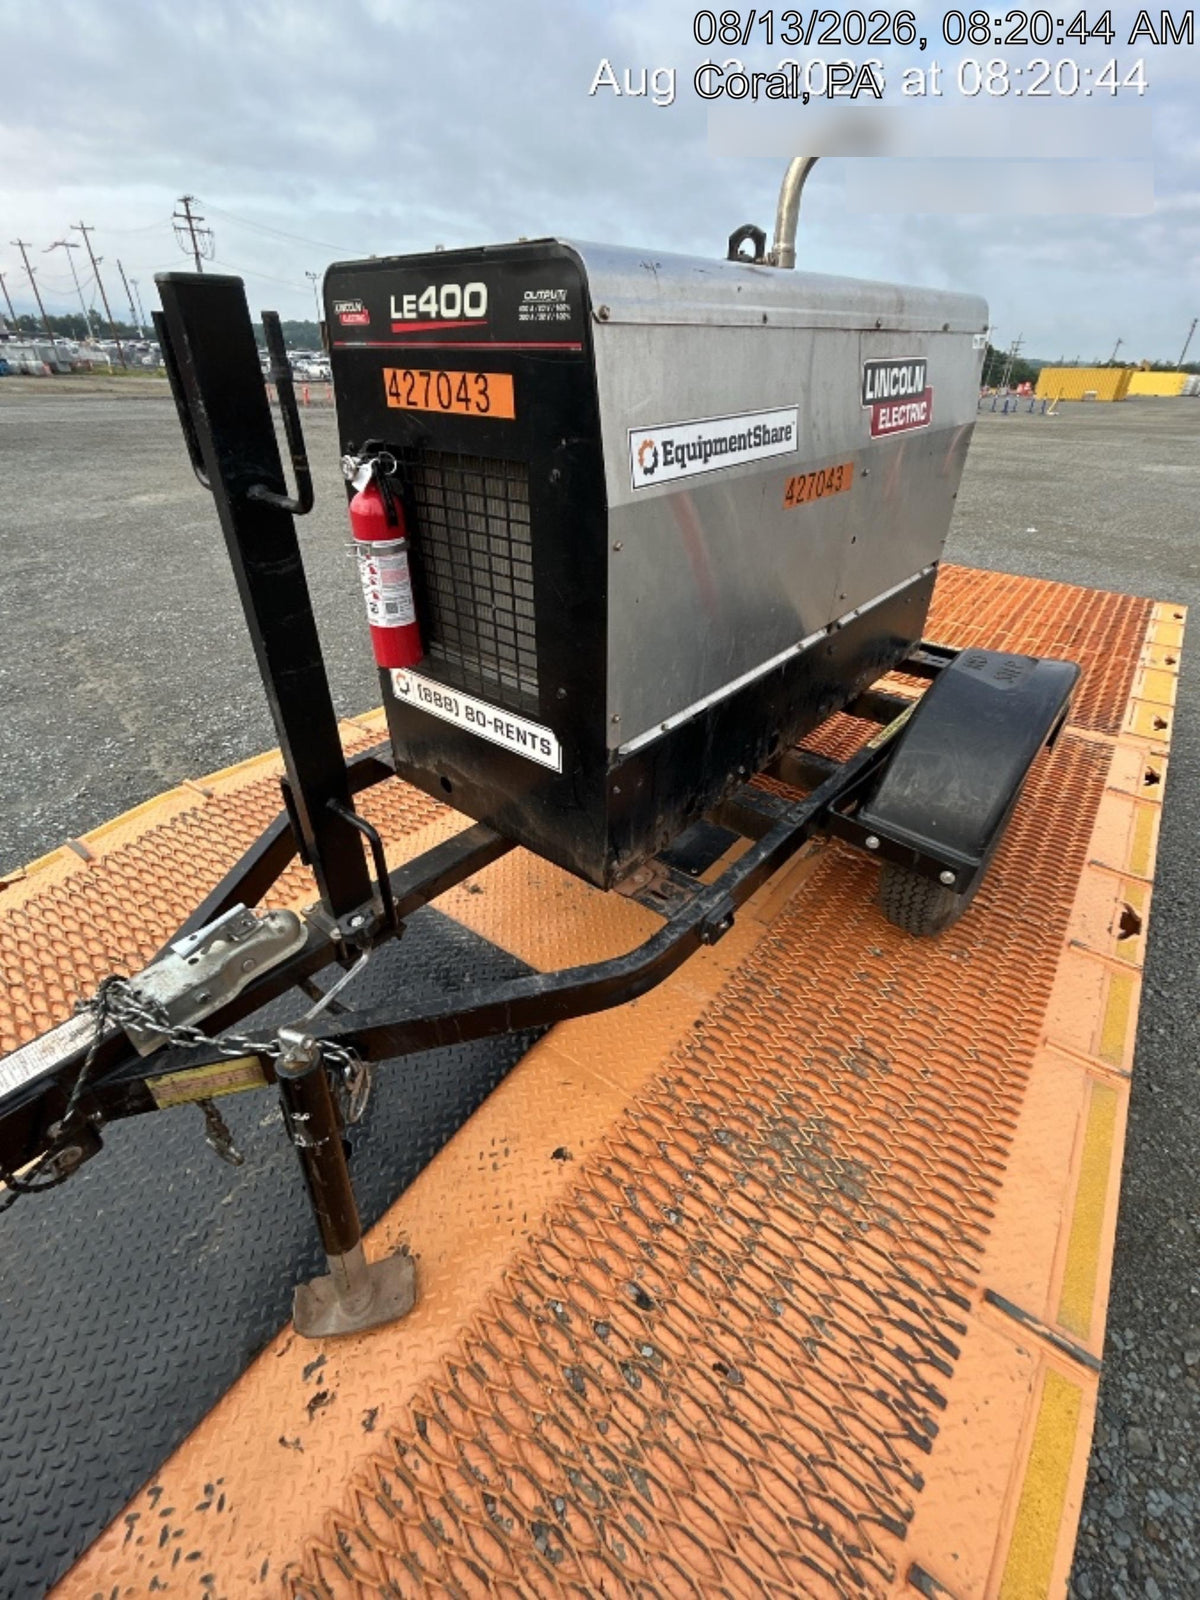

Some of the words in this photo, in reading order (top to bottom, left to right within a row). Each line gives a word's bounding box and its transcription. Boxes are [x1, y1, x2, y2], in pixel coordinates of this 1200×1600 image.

[390, 282, 488, 319] LE400
[388, 370, 490, 414] 427043
[865, 365, 925, 400] LINCOLN
[878, 401, 927, 430] ELECTRIC
[661, 423, 793, 467] EquipmentShare
[784, 465, 844, 505] 427043
[417, 683, 460, 717] (888)
